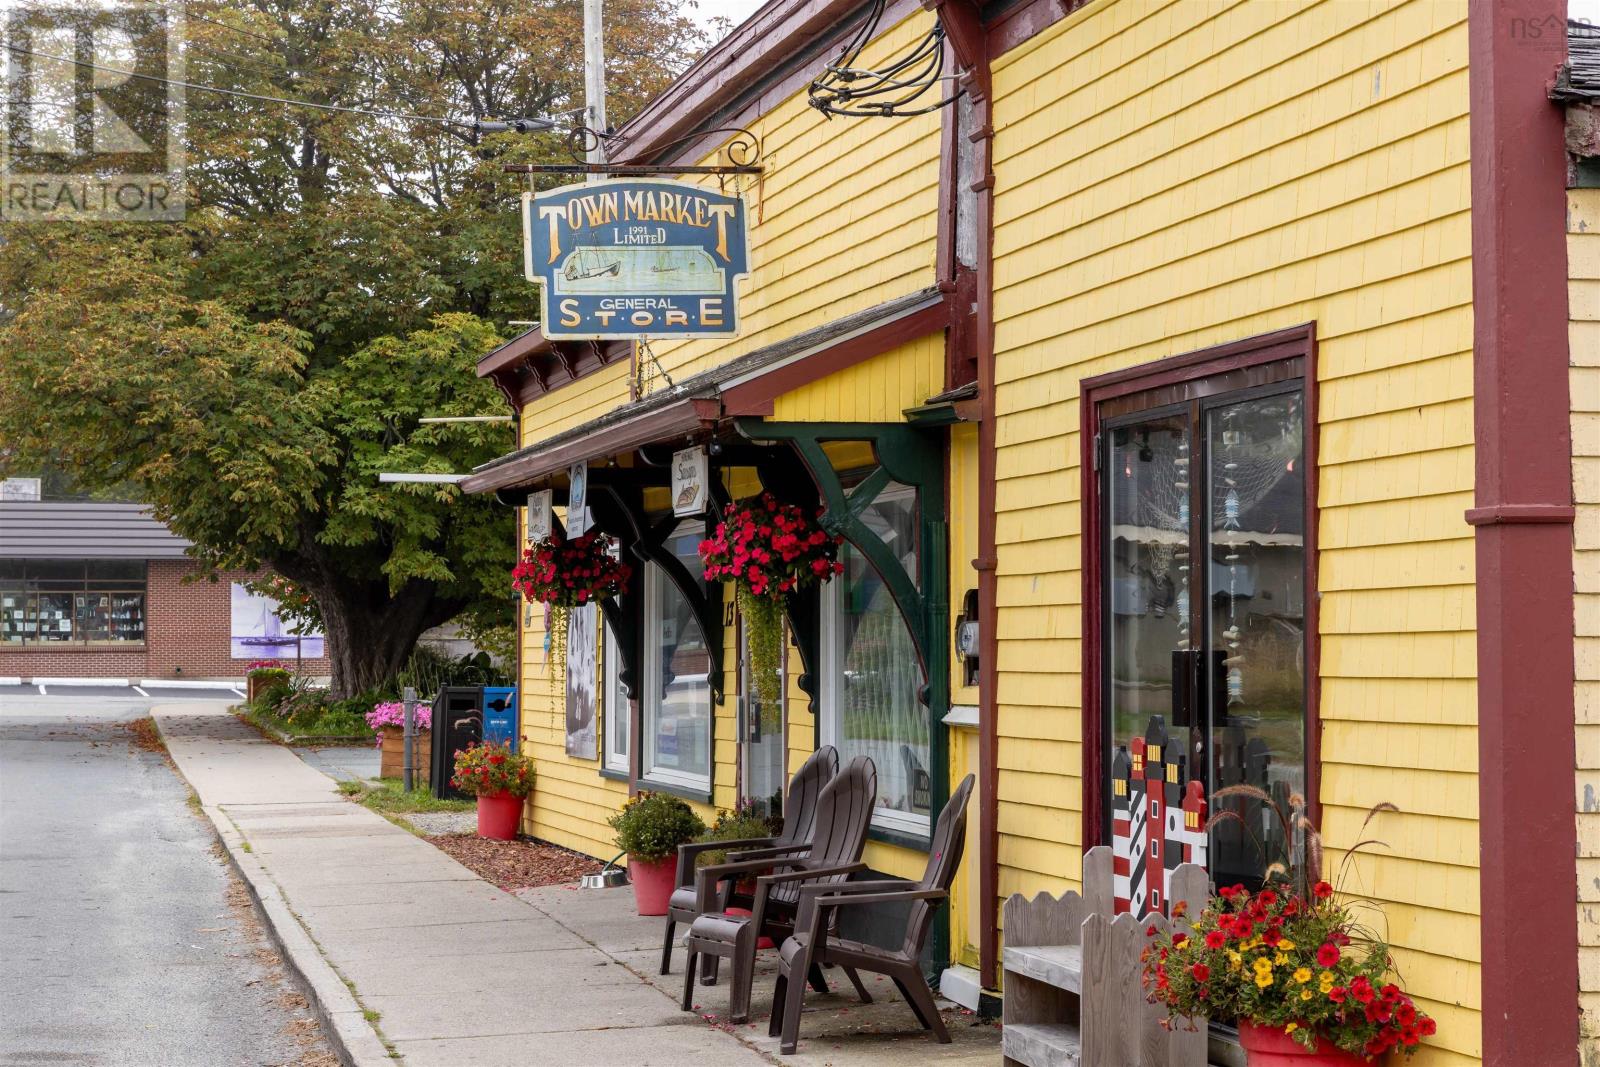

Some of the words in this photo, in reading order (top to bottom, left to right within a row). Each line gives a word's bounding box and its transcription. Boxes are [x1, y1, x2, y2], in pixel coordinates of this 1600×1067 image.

[539, 191, 618, 265] TOWN
[623, 190, 736, 263] MARKET
[628, 226, 648, 235] 1991
[613, 227, 666, 245] LIMITED
[599, 298, 678, 310] GENERAL
